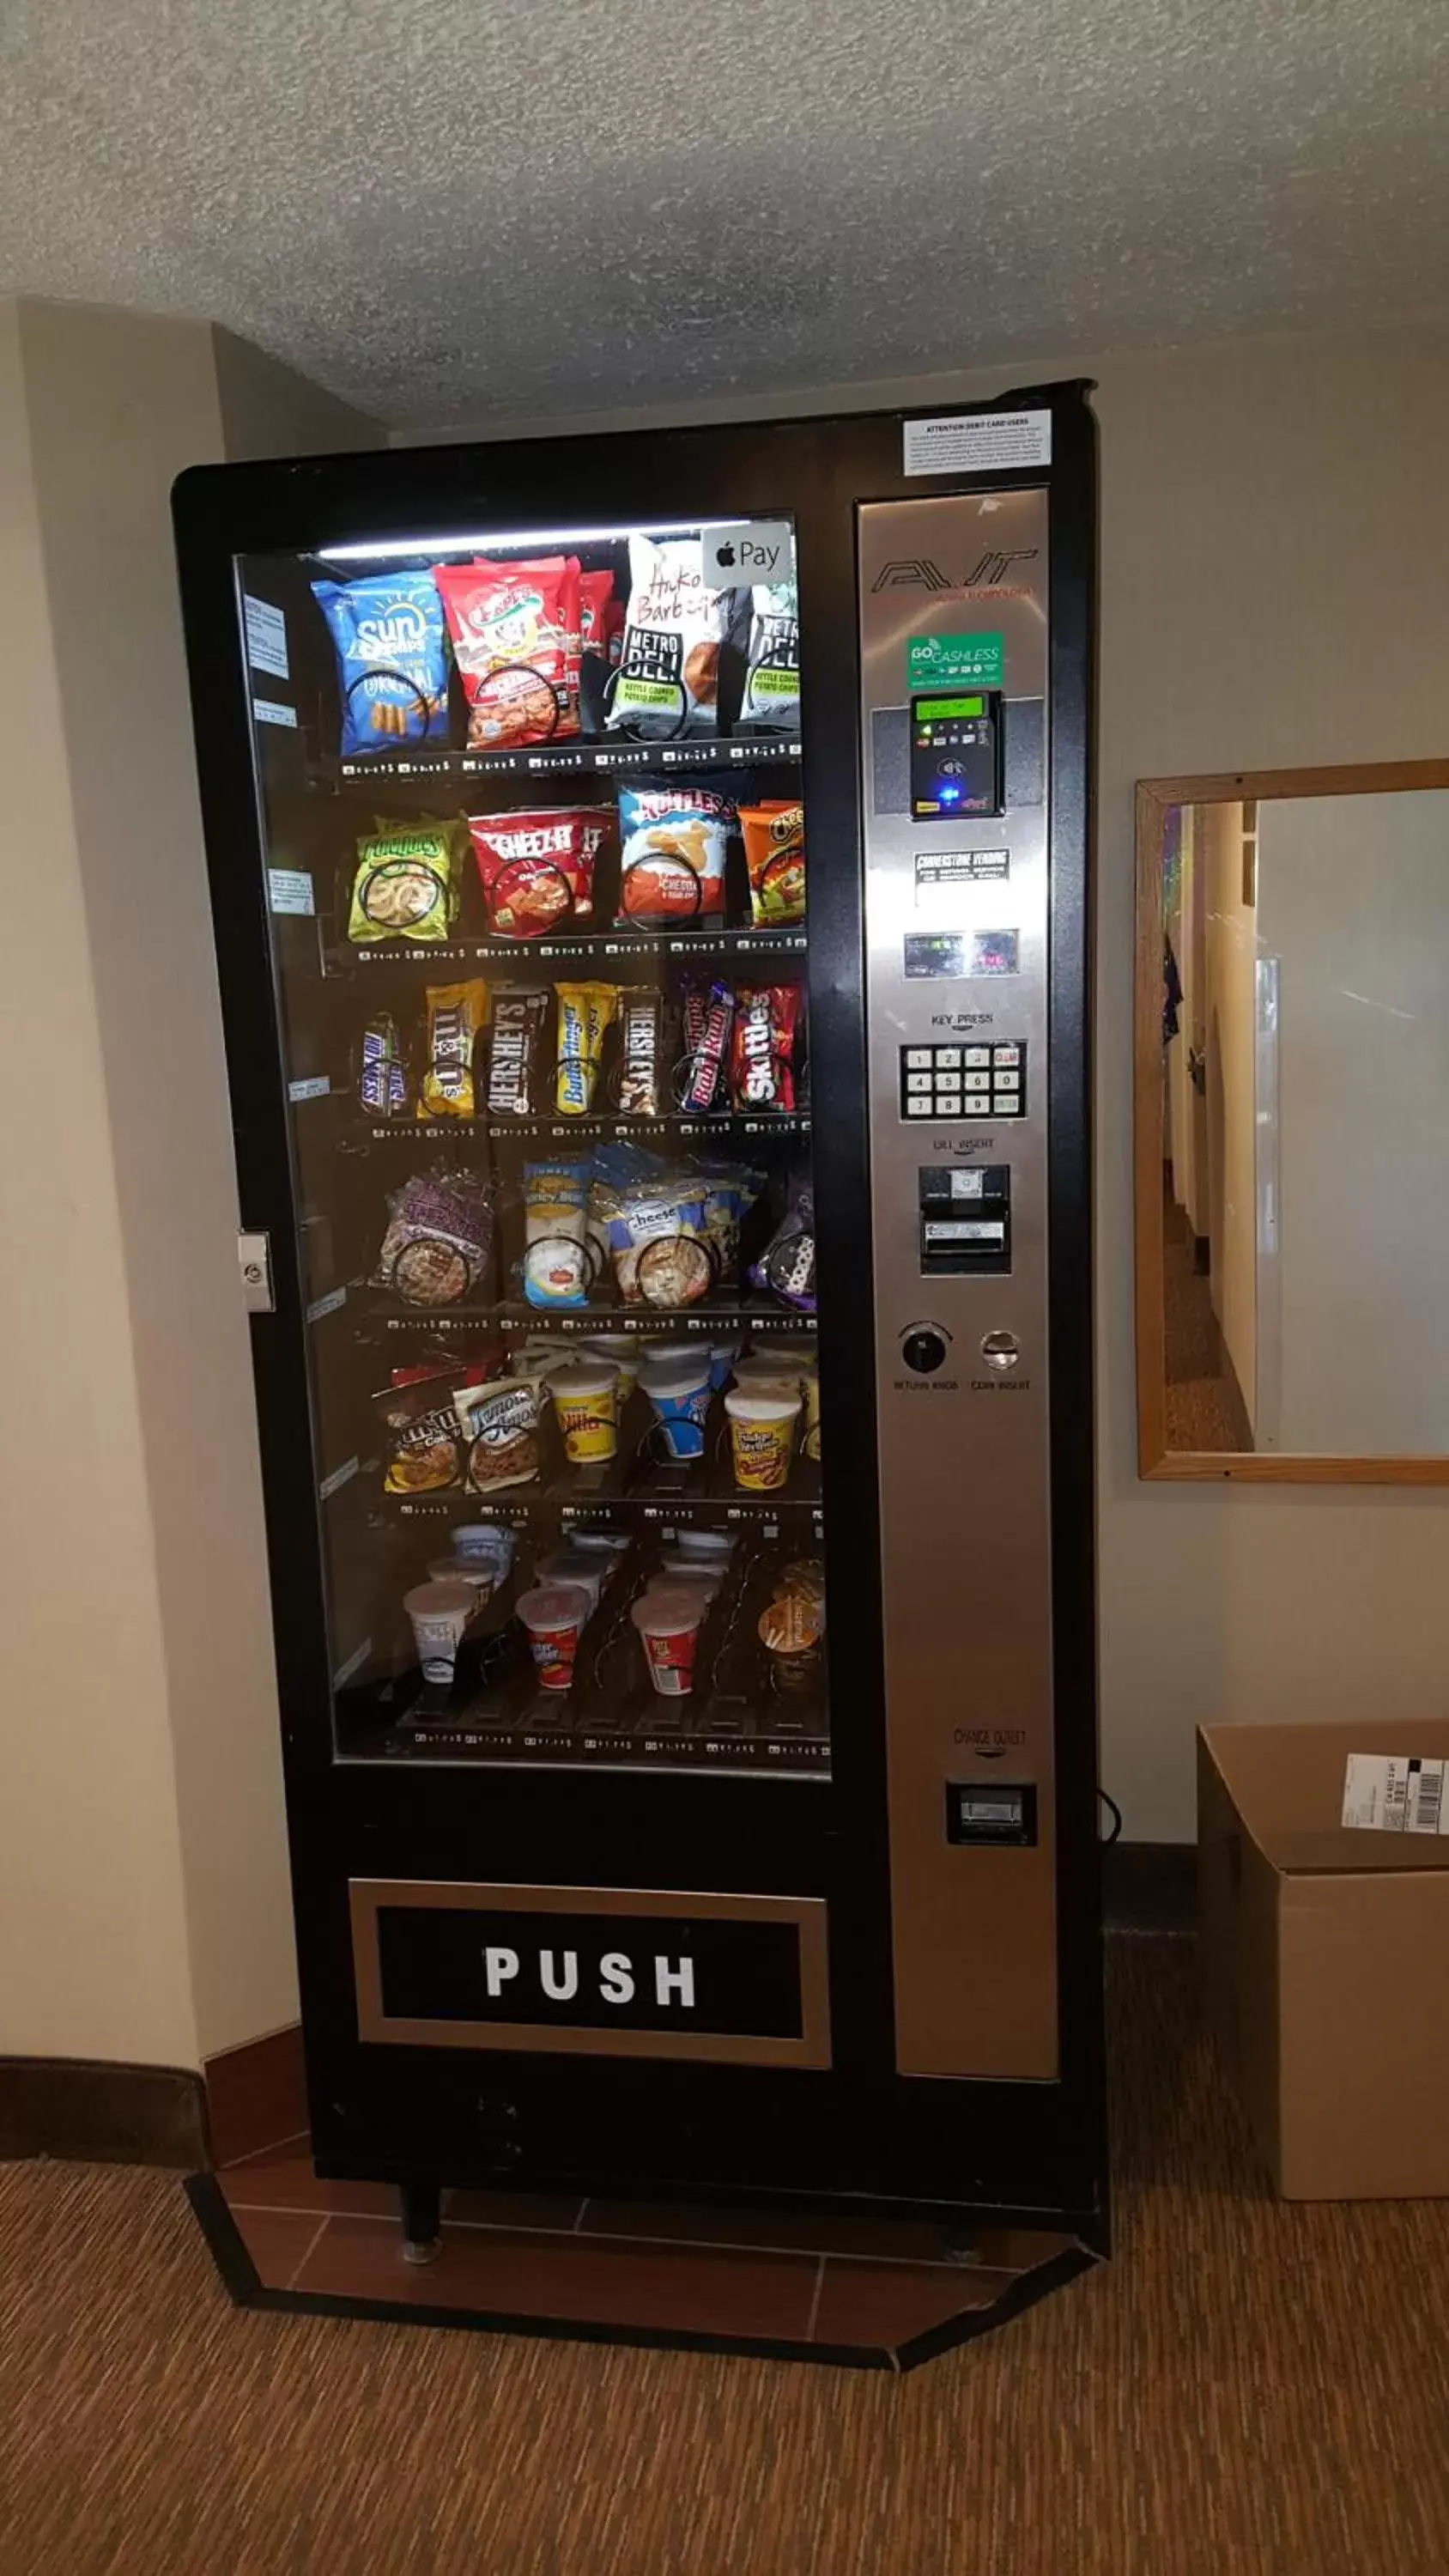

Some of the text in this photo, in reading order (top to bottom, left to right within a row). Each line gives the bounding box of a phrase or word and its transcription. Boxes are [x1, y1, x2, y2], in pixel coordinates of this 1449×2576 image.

[740, 540, 780, 571] Pay
[630, 630, 678, 653] METRO
[912, 647, 1000, 664] GO CASHLESS
[770, 807, 804, 841] Chee
[931, 1014, 994, 1026] KEY PRESS
[488, 1003, 526, 1114] HERSHEY'S
[945, 1054, 953, 1064] 2
[916, 1077, 924, 1087] 4
[945, 1077, 953, 1087] 5
[945, 1100, 953, 1110] 8
[484, 1946, 696, 2008] PUSH
